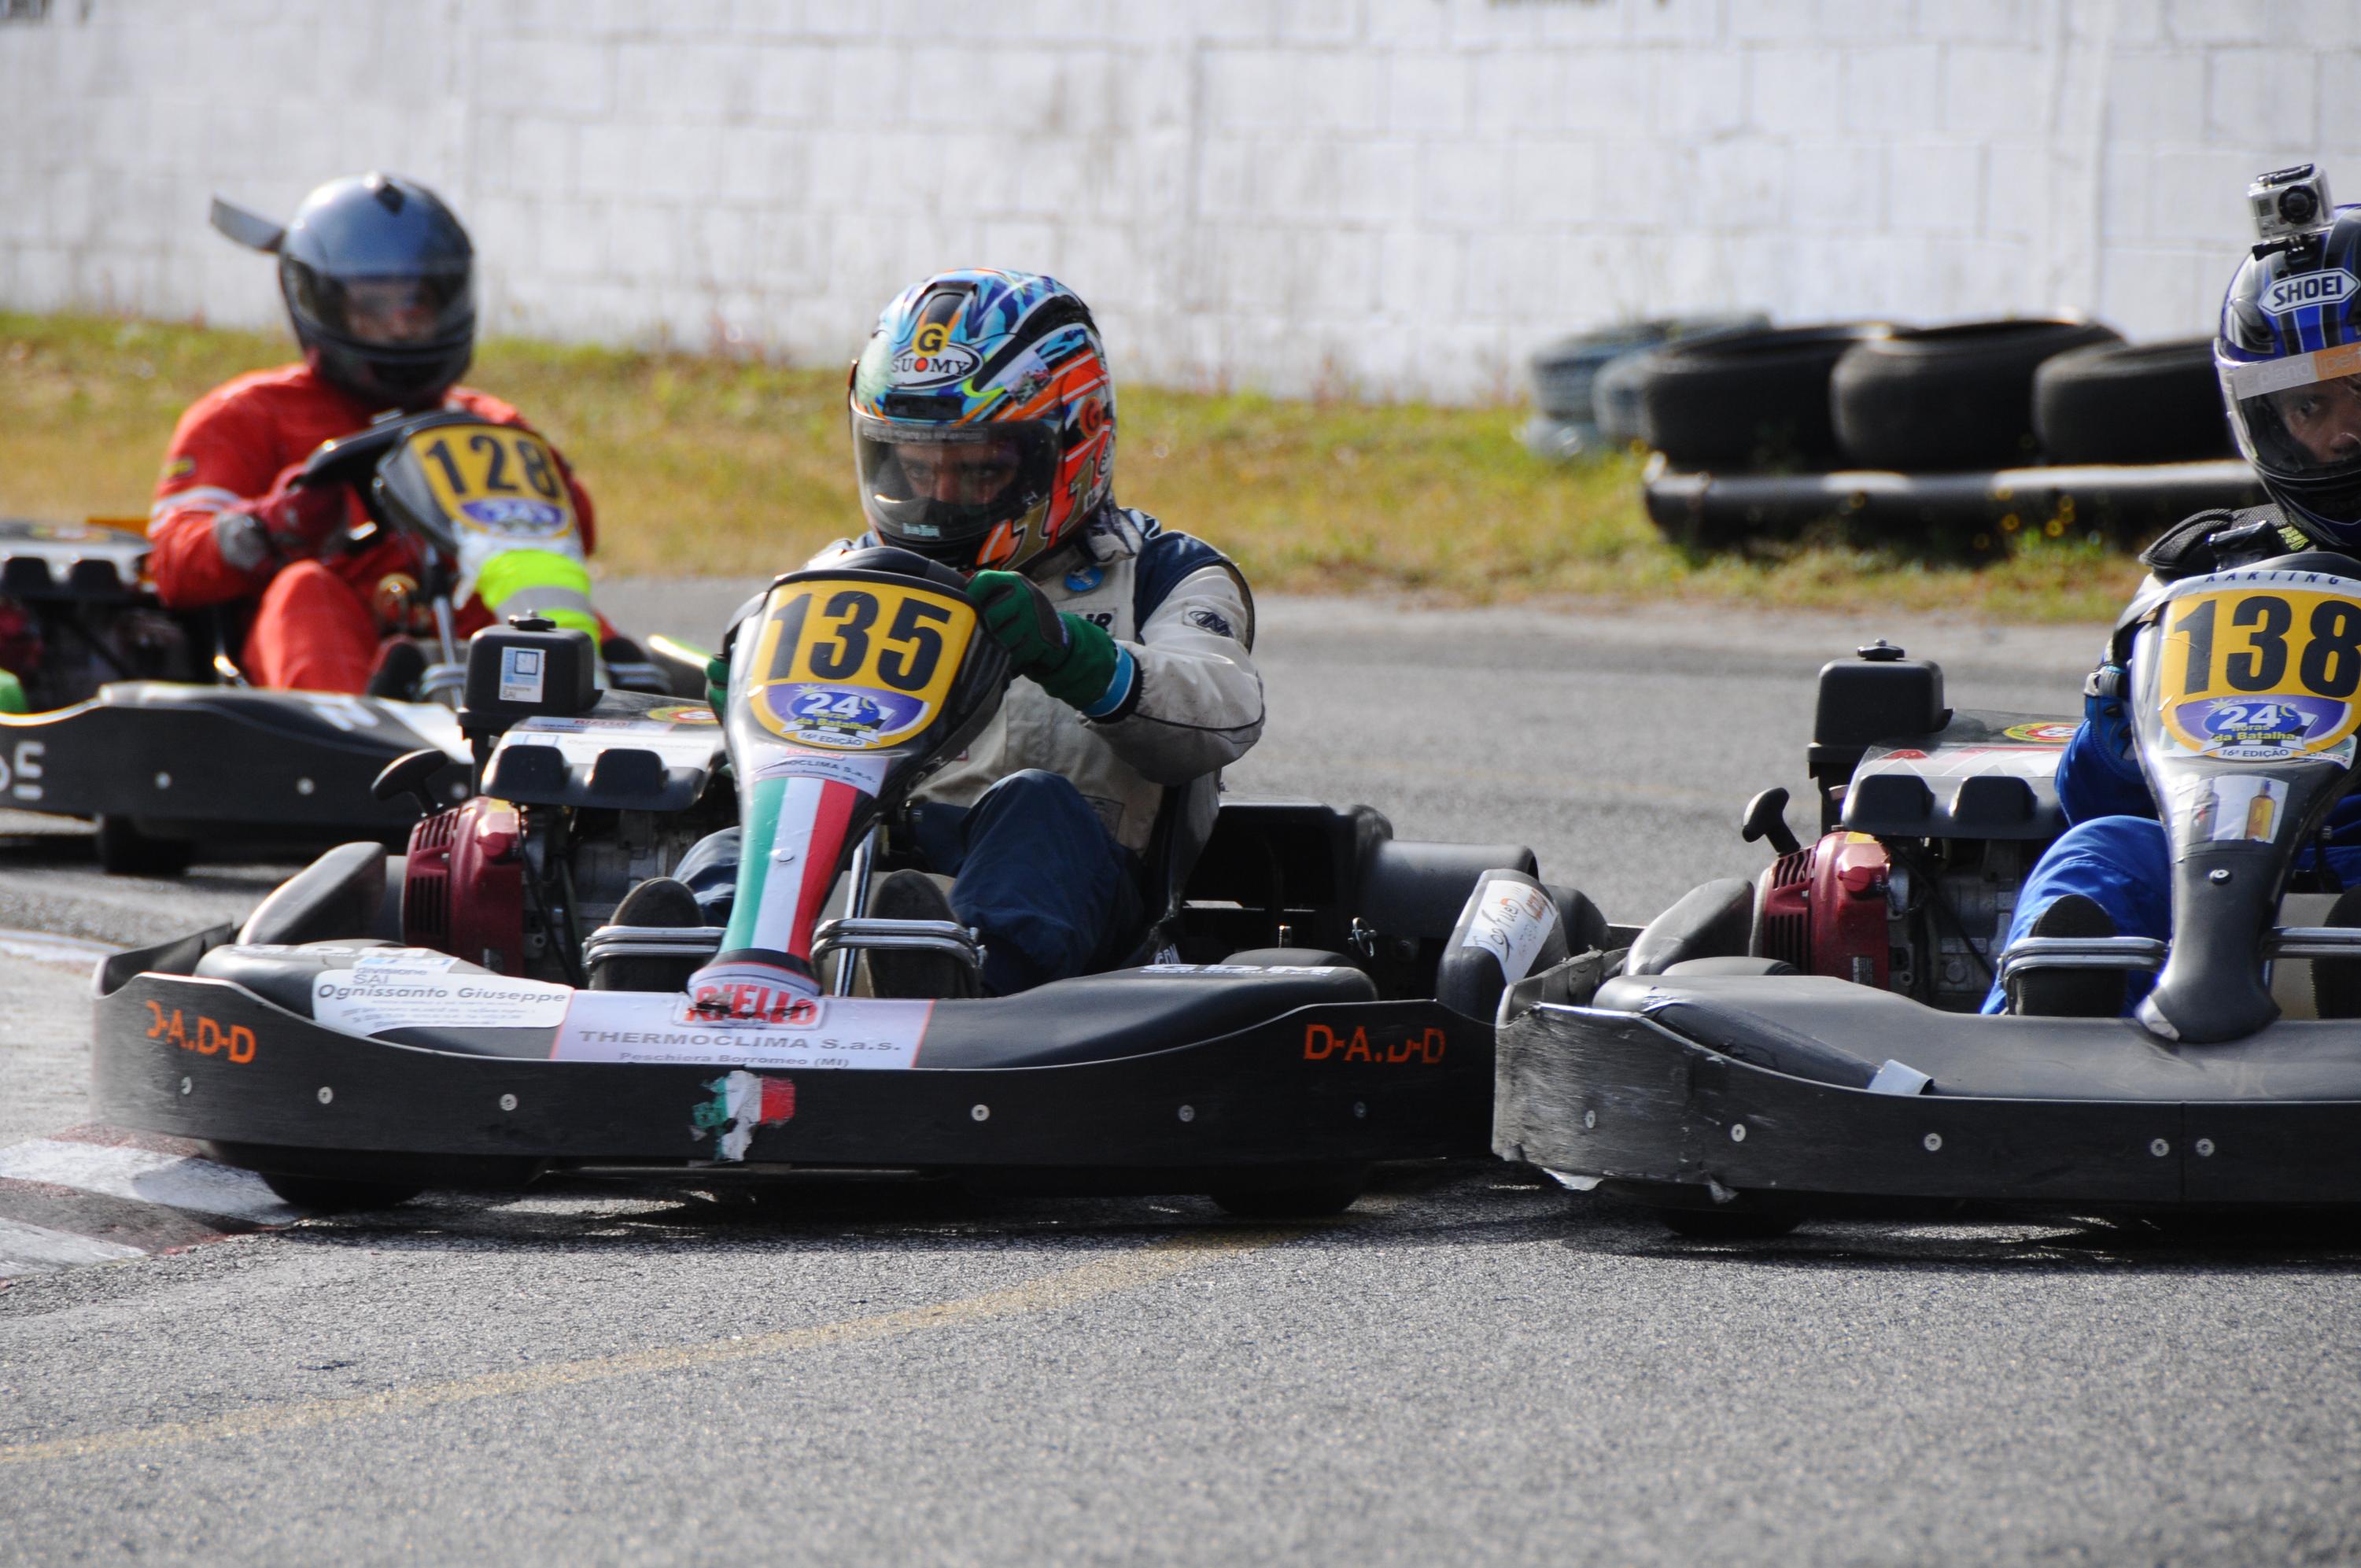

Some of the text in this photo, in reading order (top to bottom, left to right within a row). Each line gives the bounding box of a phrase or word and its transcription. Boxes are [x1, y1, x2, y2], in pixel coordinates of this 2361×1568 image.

[2273, 275, 2342, 307] SHOEI
[918, 328, 943, 352] G
[891, 357, 969, 375] SUOMY
[425, 434, 559, 498] 128
[767, 590, 952, 692] 135
[2173, 596, 2361, 698] 138
[800, 692, 862, 718] 24
[795, 717, 872, 732] da Batalha
[2217, 704, 2281, 730] 24
[820, 735, 863, 747] EDIÇÃO
[2214, 732, 2296, 743] da Batalha
[2243, 747, 2289, 758] EDIÇÃO
[352, 974, 389, 984] SAI
[318, 983, 566, 1003] Ognissanto Giuseppe
[579, 1031, 902, 1051] THERMOCLIMA S.a.s.
[619, 1052, 850, 1068] Peschiera Borromeo (MI)
